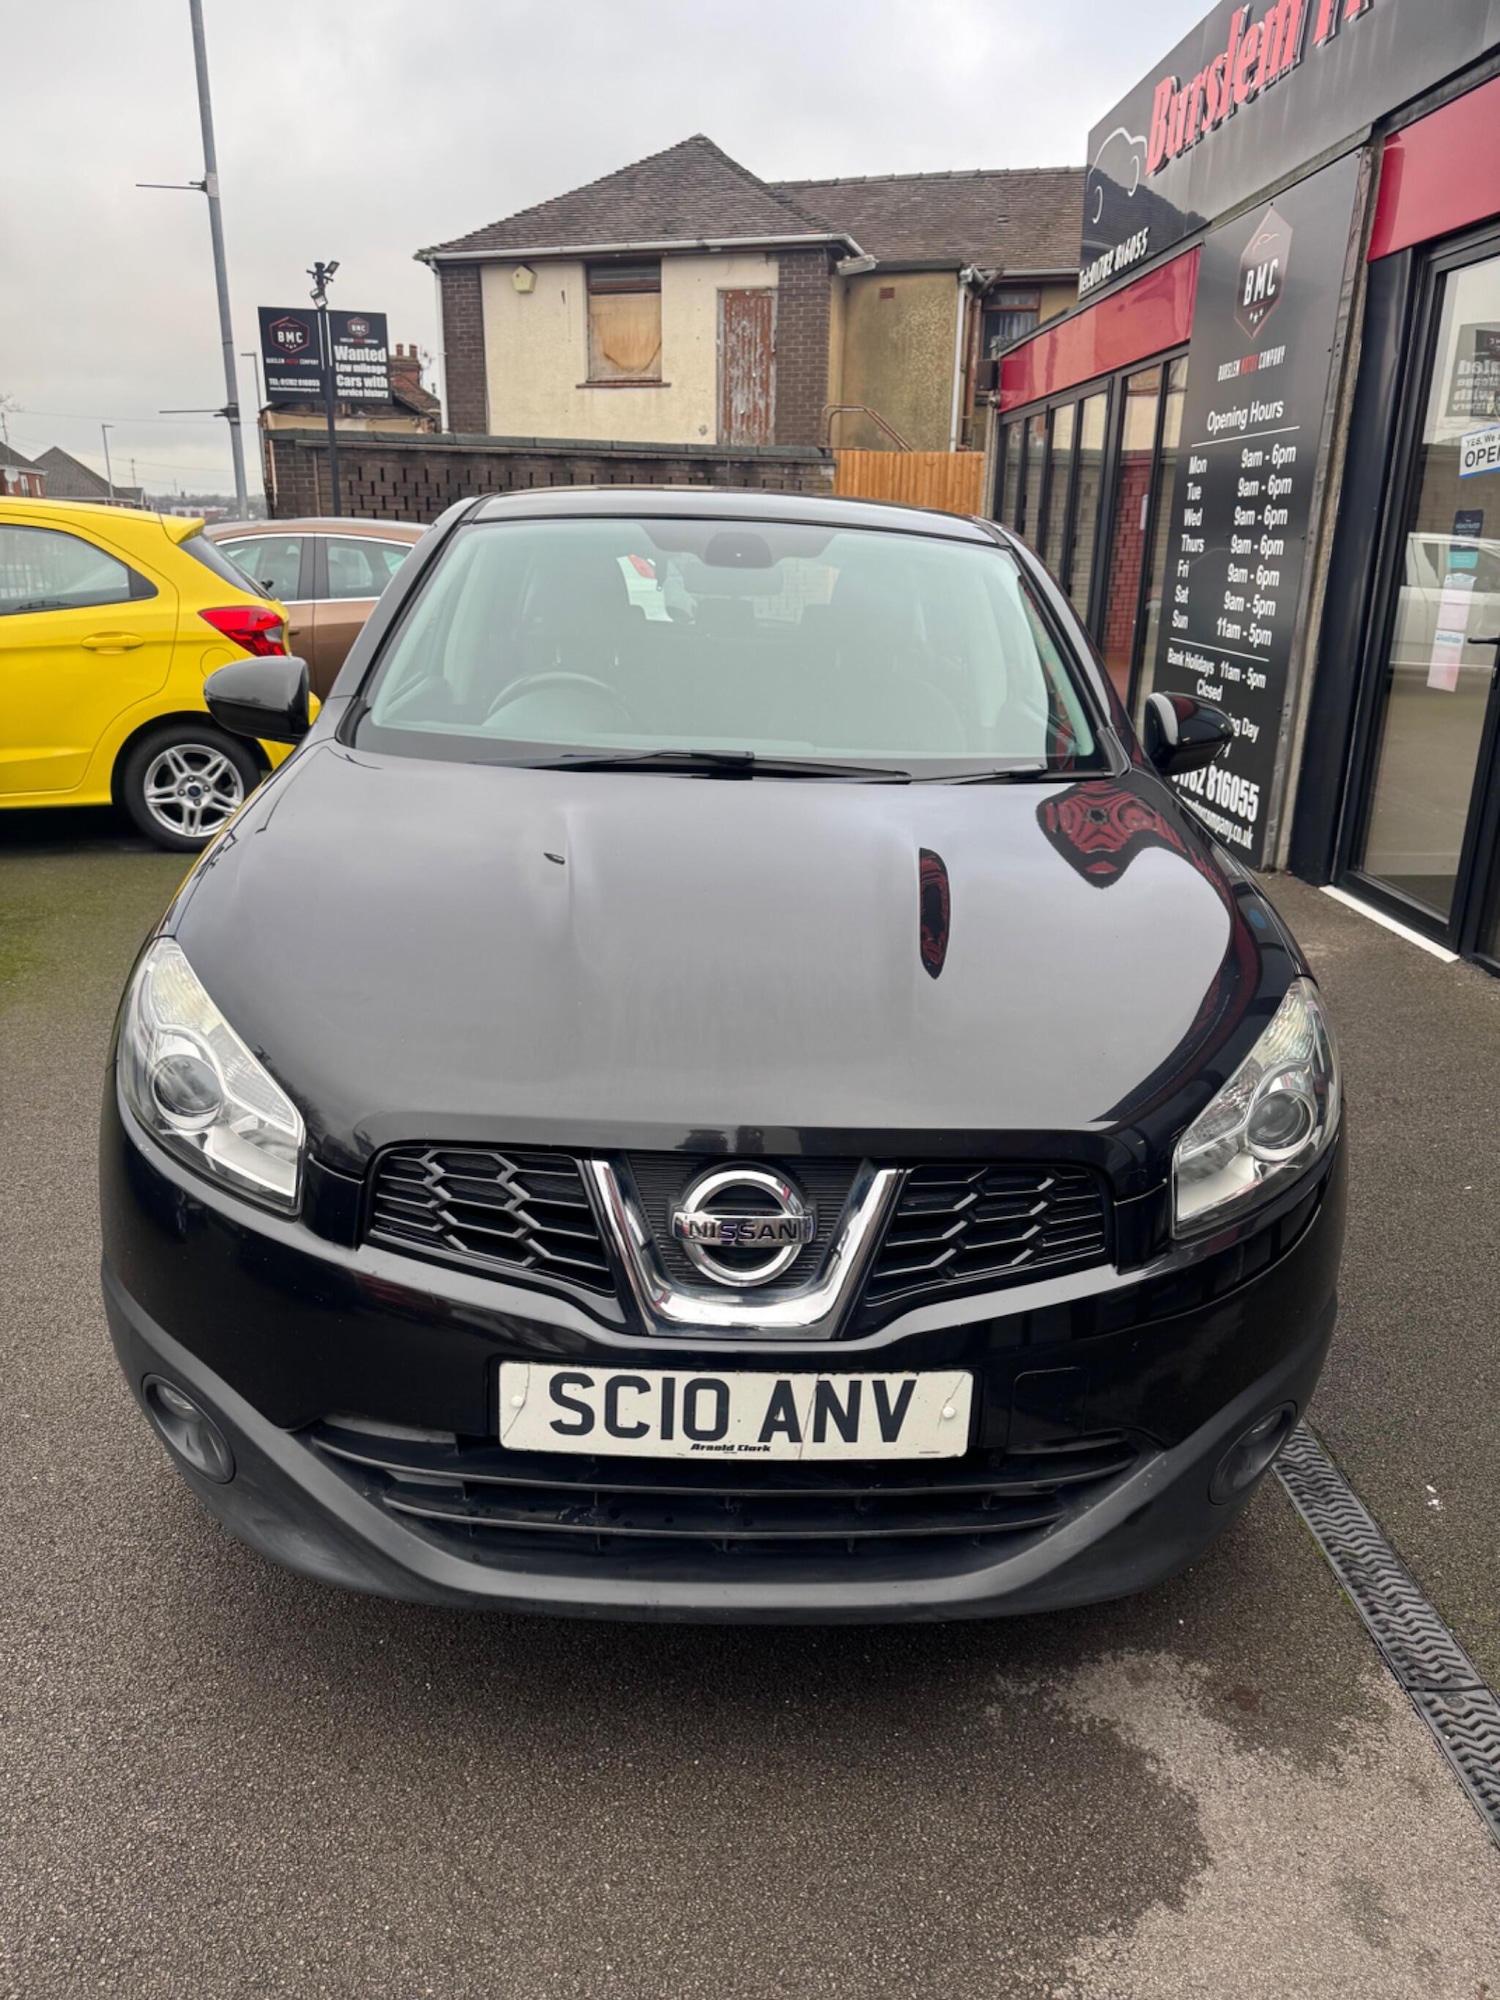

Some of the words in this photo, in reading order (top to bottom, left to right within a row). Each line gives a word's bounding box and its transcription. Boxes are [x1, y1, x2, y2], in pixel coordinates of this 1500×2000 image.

[1145, 0, 1304, 177] Burslem
[1243, 258, 1279, 306] BMC
[277, 331, 303, 343] BMC
[334, 345, 387, 362] Wanted
[335, 362, 352, 372] Low
[353, 363, 387, 375] mileage
[336, 374, 362, 388] Cars
[363, 376, 388, 388] with
[337, 388, 363, 397] service
[364, 389, 389, 399] history
[1207, 406, 1248, 435] Opening
[1250, 400, 1284, 422] Hours
[1188, 455, 1207, 474] Mon
[1241, 448, 1262, 468] 9am
[1271, 444, 1296, 469] 6pm
[1187, 482, 1202, 500] Tue
[1238, 477, 1259, 497] 9am
[1267, 474, 1292, 499] 6pm
[1184, 508, 1202, 526] Wed
[1234, 506, 1255, 526] 9am
[1263, 504, 1288, 530] 6pm
[1181, 534, 1205, 552] Thurs
[1231, 534, 1252, 554] 9am
[1260, 534, 1284, 560] 6pm
[1177, 560, 1190, 578] Fri
[1228, 563, 1248, 583] 9am
[1256, 565, 1280, 590] 6pm
[1175, 585, 1189, 604] Sat
[1224, 591, 1244, 612] 9am
[1253, 594, 1276, 619] 5pm
[1172, 610, 1188, 629] Sun
[1217, 618, 1241, 638] 11am
[1249, 624, 1272, 648] 5pm
[1167, 648, 1184, 667] Bank
[1185, 652, 1215, 678] Holidays
[1220, 661, 1241, 682] 11am
[1247, 667, 1267, 691] 5pm
[1196, 679, 1223, 701] Closed
[1241, 717, 1259, 743] Day
[1206, 764, 1260, 822] 816055
[689, 1219, 798, 1243] NISSAN
[548, 1372, 730, 1441] SC10
[757, 1379, 918, 1443] ANV
[690, 1443, 736, 1451] Arnold
[737, 1444, 771, 1452] Clark
